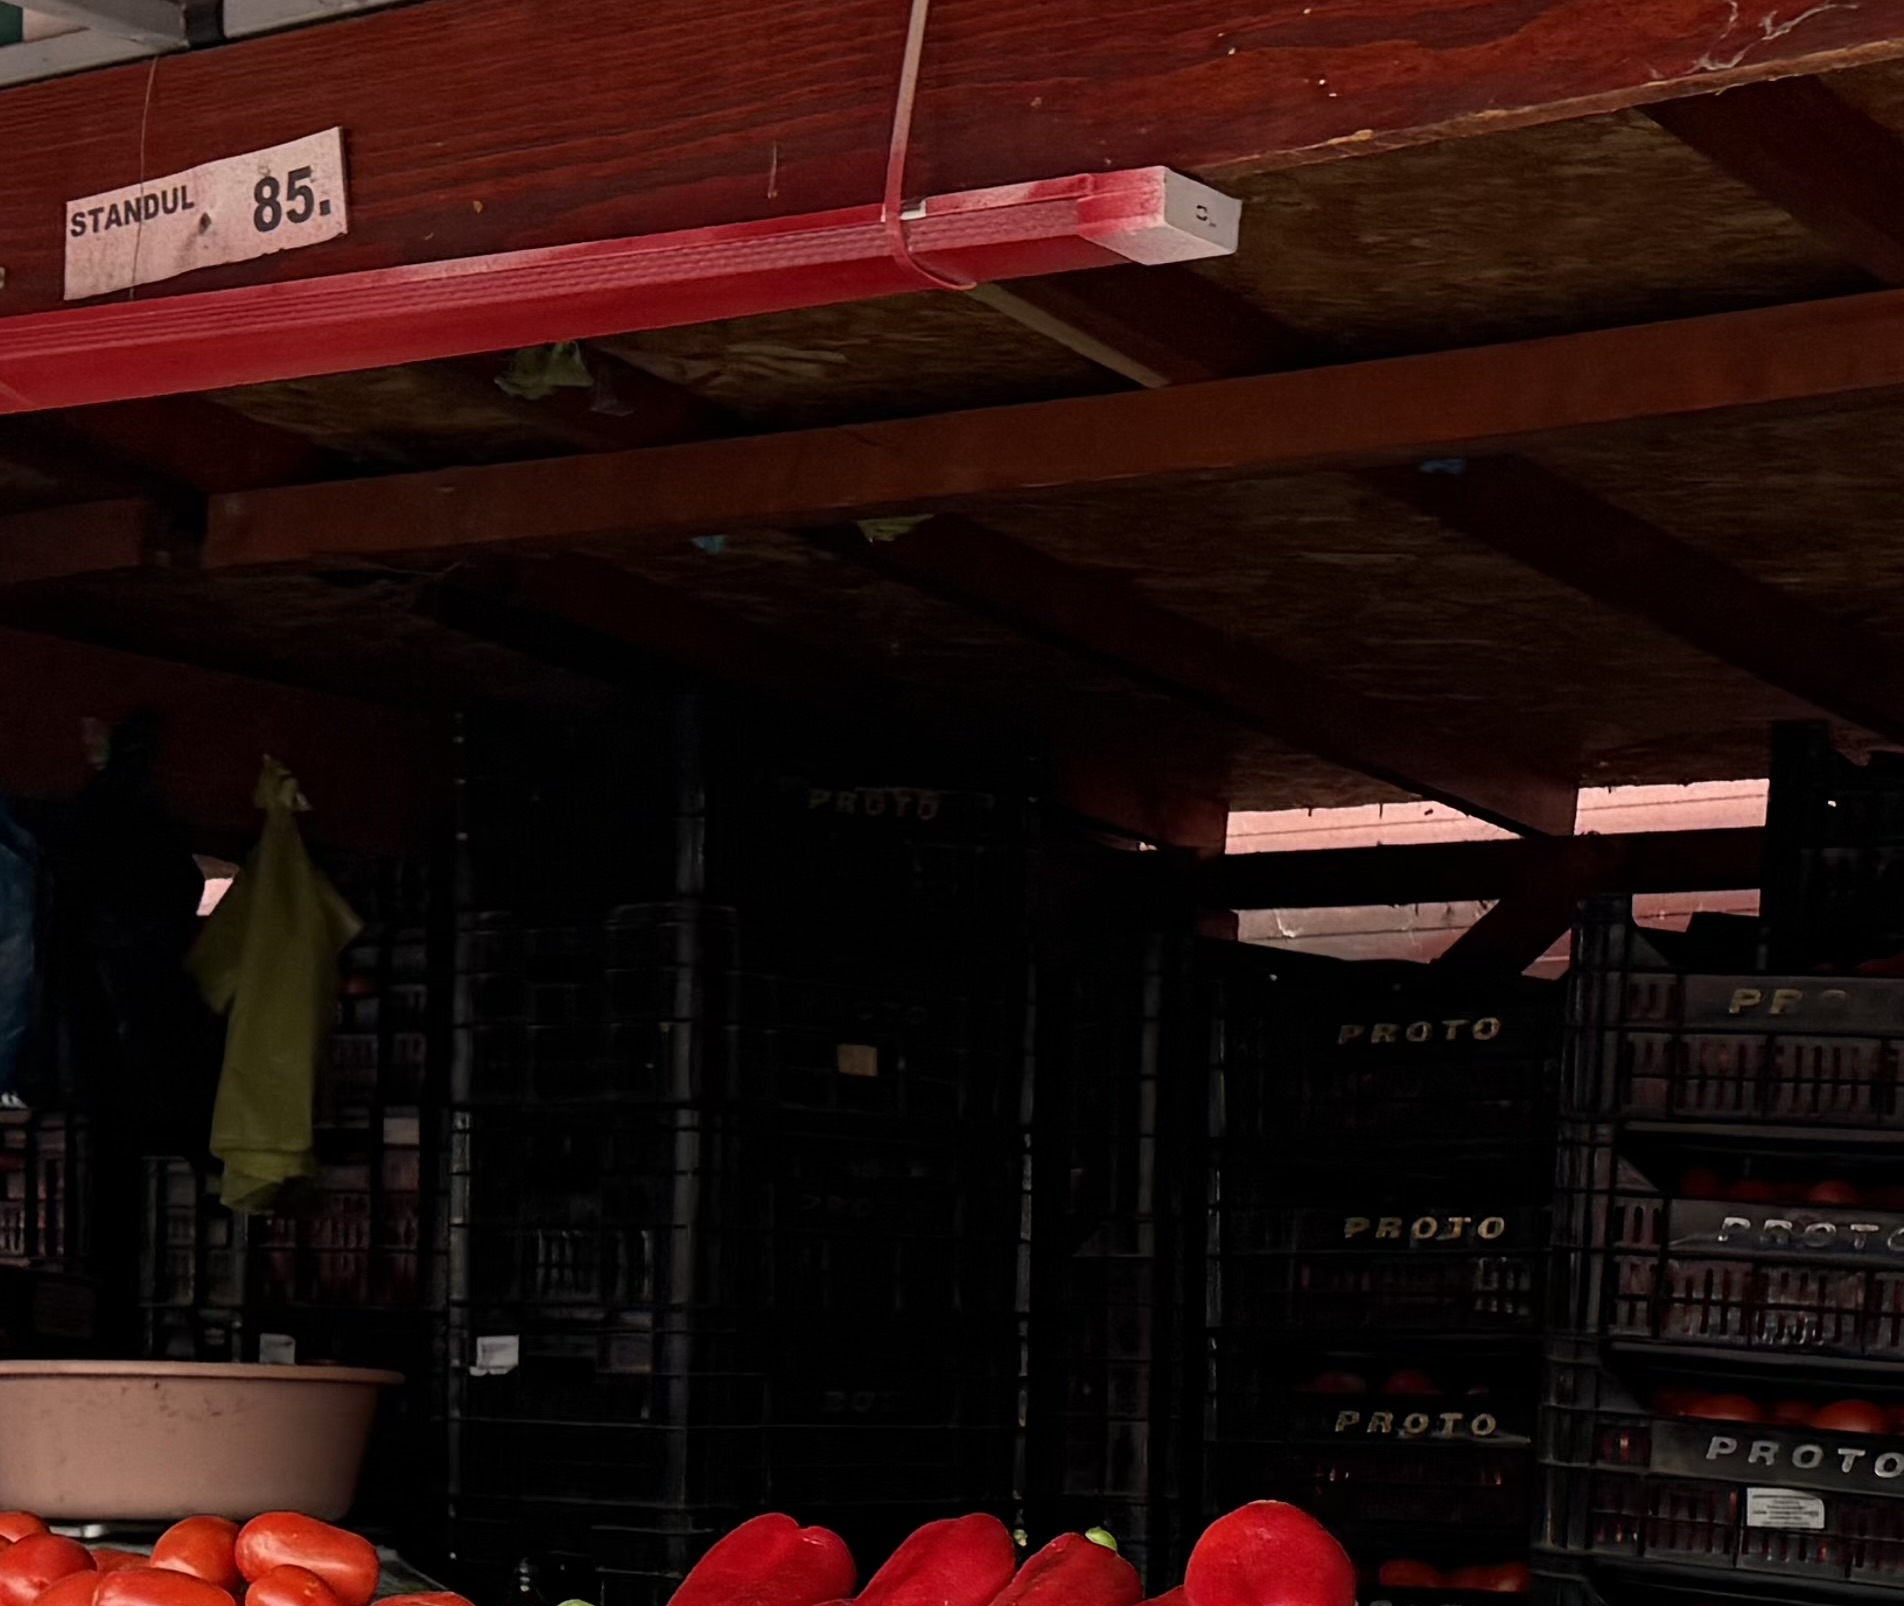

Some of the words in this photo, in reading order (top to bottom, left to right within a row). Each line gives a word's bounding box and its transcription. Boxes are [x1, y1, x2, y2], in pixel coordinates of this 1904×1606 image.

[70, 184, 195, 238] STANDUL
[808, 788, 940, 821] PROTO
[1336, 1015, 1504, 1045] PROTO
[1343, 1215, 1507, 1241] PROTO
[1334, 1409, 1499, 1438] PROTO
